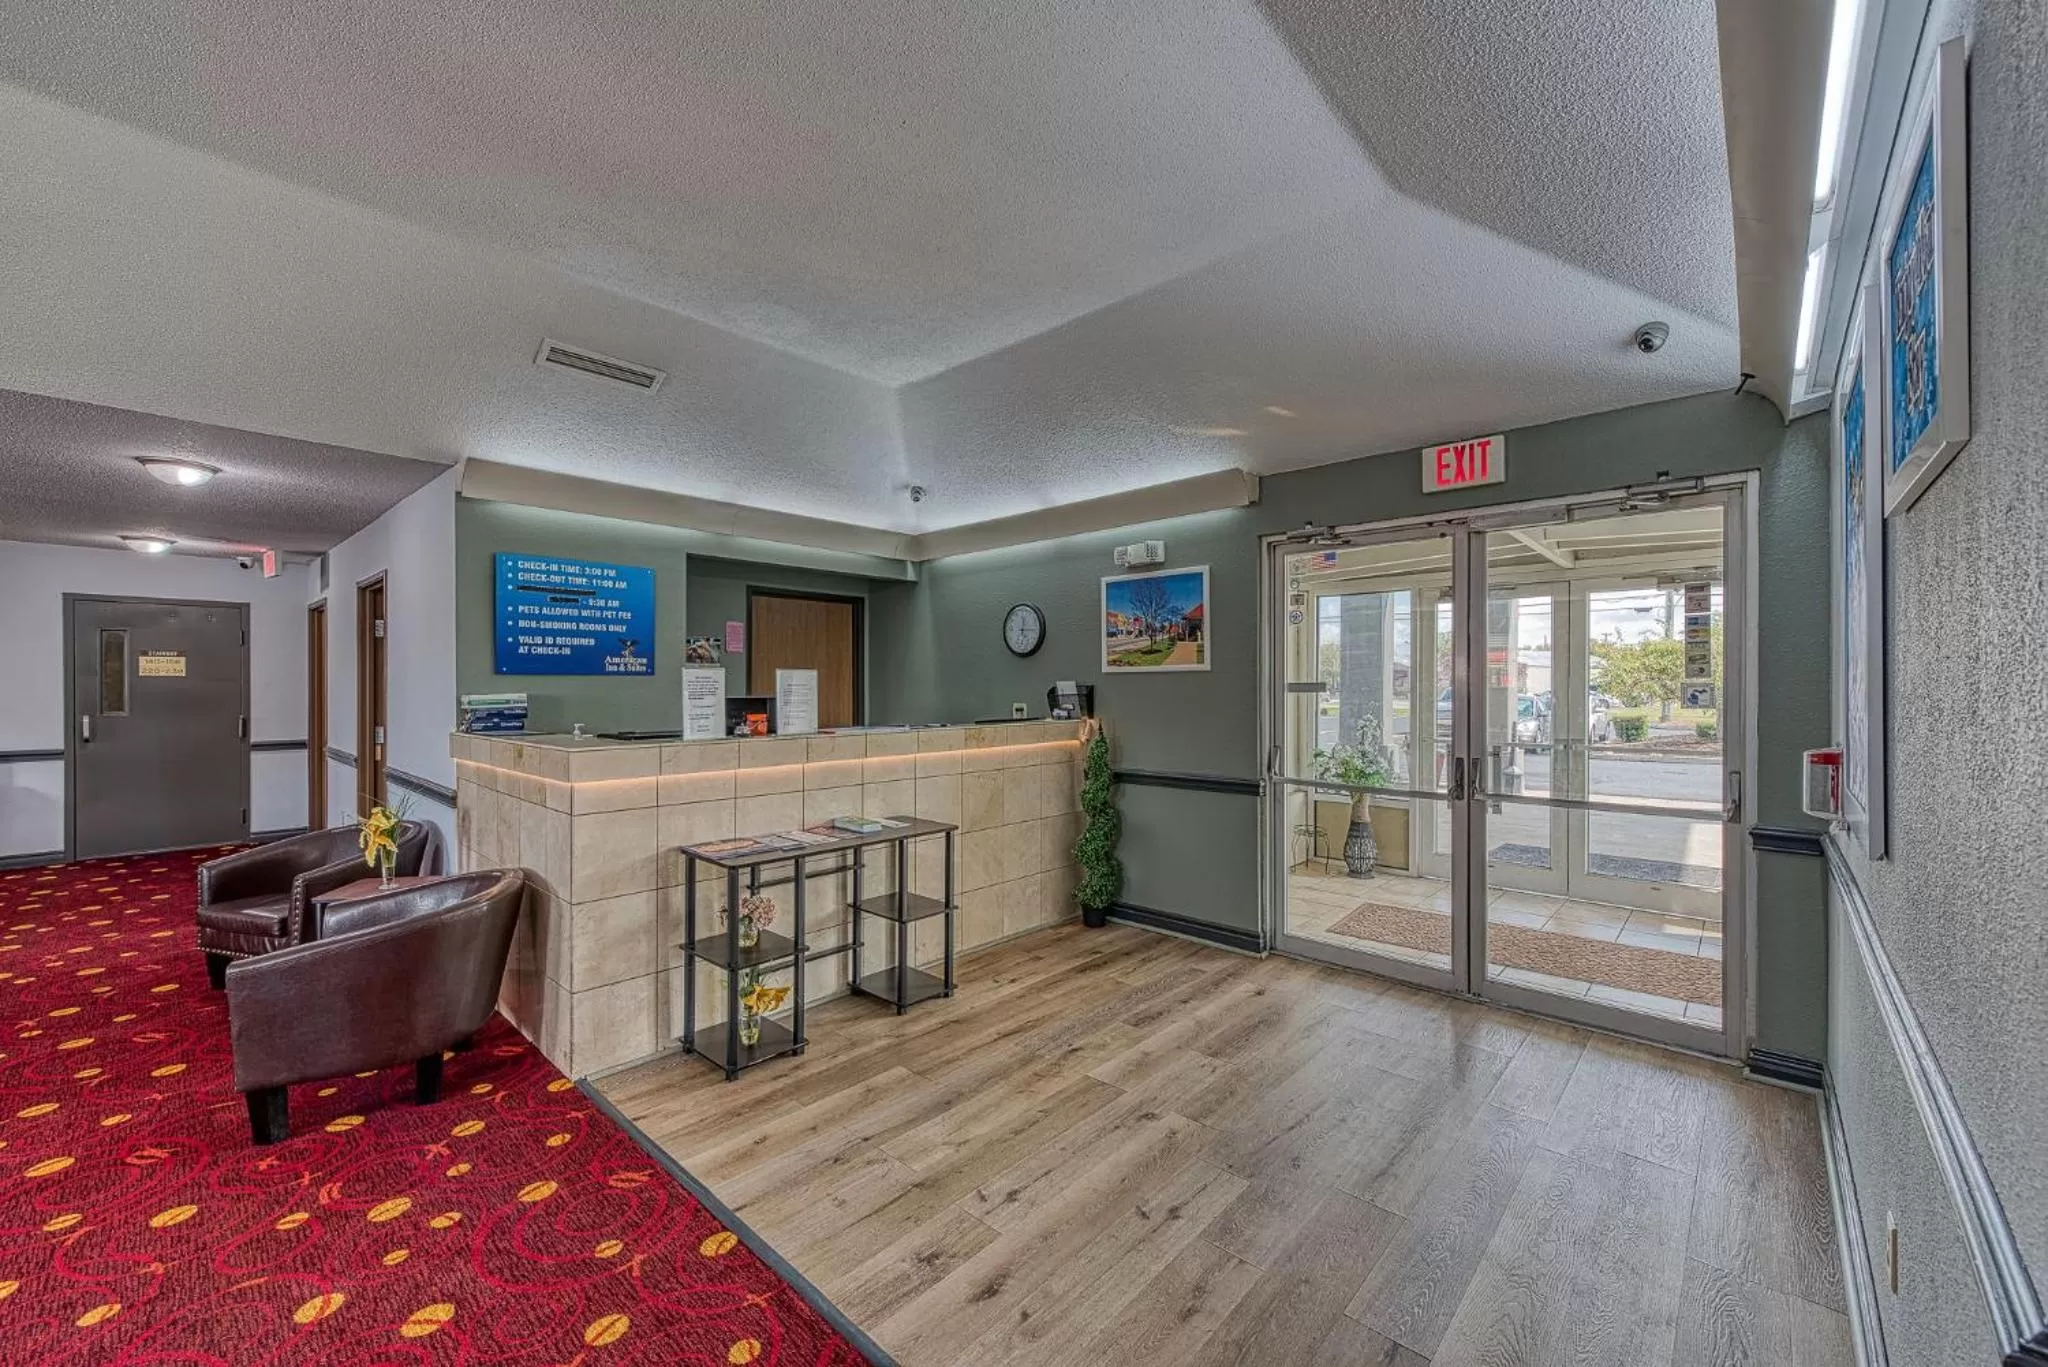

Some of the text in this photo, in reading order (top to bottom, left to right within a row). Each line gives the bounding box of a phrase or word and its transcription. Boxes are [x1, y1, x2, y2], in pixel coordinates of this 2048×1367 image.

[1435, 439, 1492, 486] EXIT
[518, 560, 558, 571] CHECK-IN
[560, 564, 583, 574] TIME:
[603, 568, 617, 577] PM
[518, 572, 566, 583] CHECK-OUT
[567, 575, 590, 585] TIME:
[615, 580, 628, 589] AM
[607, 599, 620, 608] AM
[518, 605, 632, 620] PETS ALLOWED WITH PET FEE
[518, 619, 627, 633] NON-SMOKING ROOMS ONLY
[518, 635, 595, 645] VALID ID REQUIRED
[518, 646, 571, 655] AT CHECK-IN
[604, 655, 648, 664] American
[605, 663, 647, 672] Inn & Suites
